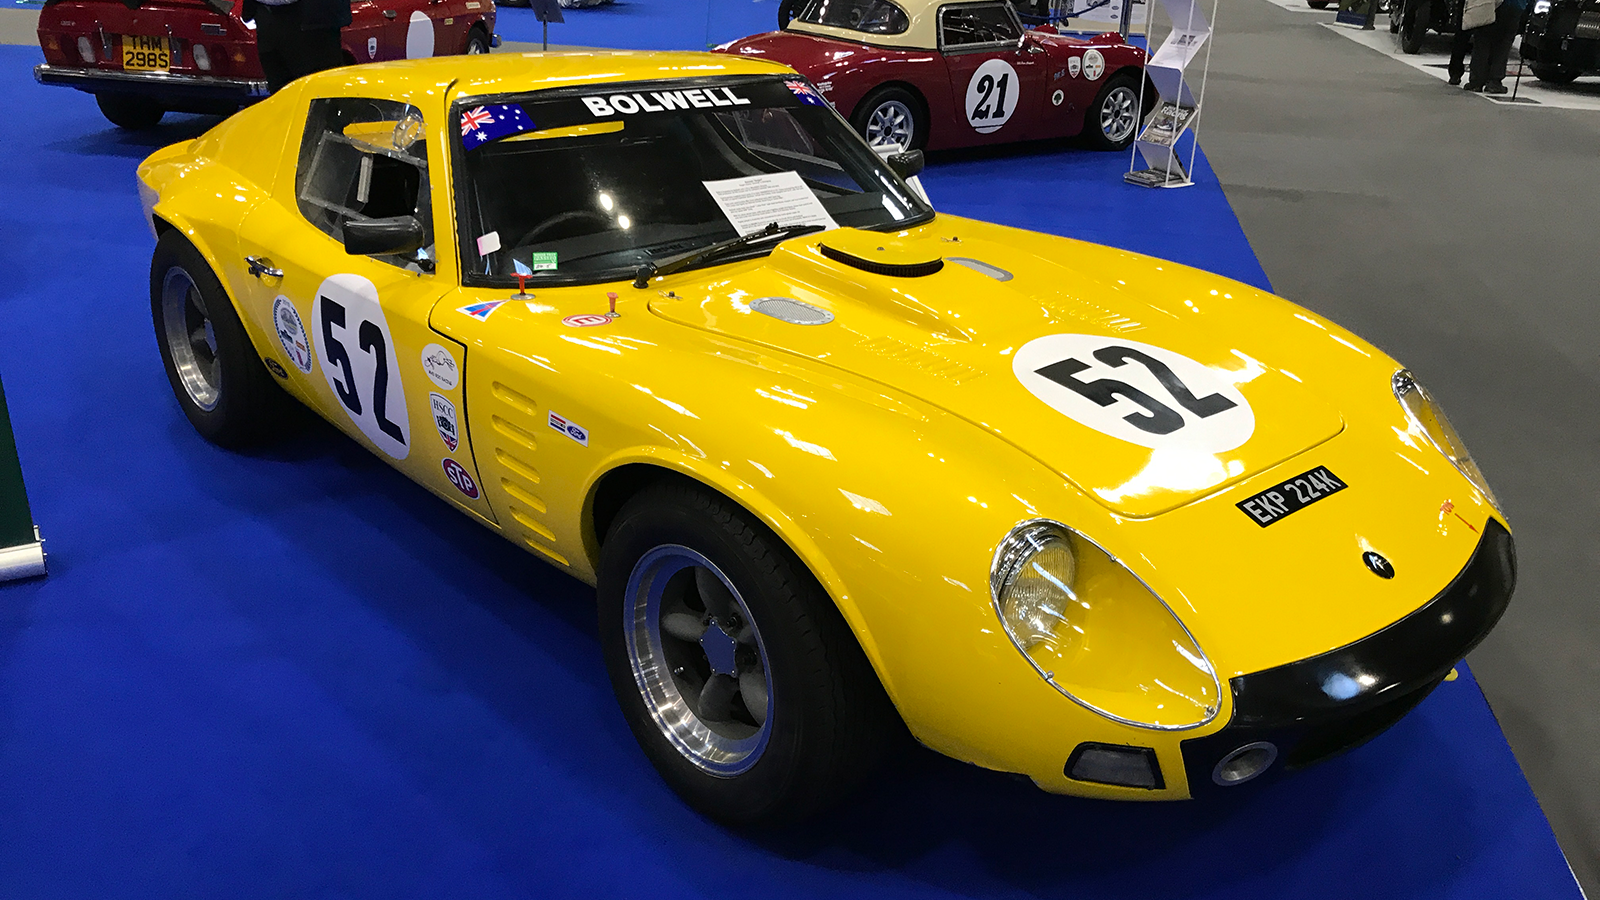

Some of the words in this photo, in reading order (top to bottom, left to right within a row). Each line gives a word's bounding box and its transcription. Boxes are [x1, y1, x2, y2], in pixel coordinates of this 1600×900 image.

[130, 35, 163, 51] THM
[125, 52, 168, 68] 298S
[581, 87, 751, 117] BOLWELL
[971, 73, 1010, 121] 21
[320, 294, 406, 447] 52
[1034, 345, 1238, 435] 52
[432, 398, 454, 420] HSCC
[570, 426, 583, 440] Ford
[447, 462, 474, 491] STP
[1243, 491, 1289, 523] EKP
[1284, 469, 1342, 503] 224K
